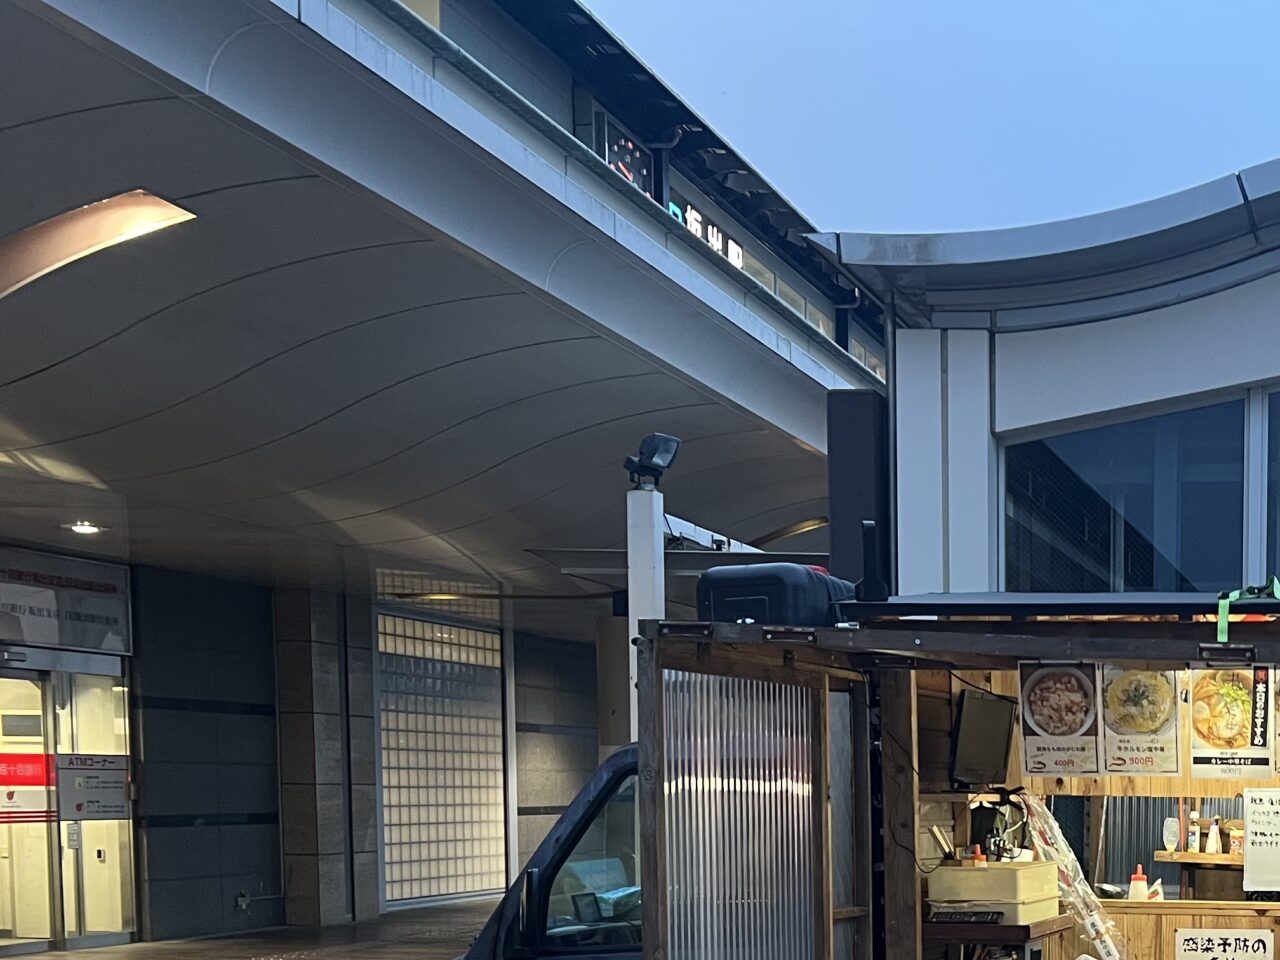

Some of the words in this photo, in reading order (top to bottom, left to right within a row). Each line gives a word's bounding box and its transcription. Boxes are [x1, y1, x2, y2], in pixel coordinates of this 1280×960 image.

[1253, 683, 1267, 746] 本日のおすすめ
[68, 757, 116, 768] ATMコーナー
[1182, 937, 1267, 955] 感染予防の
